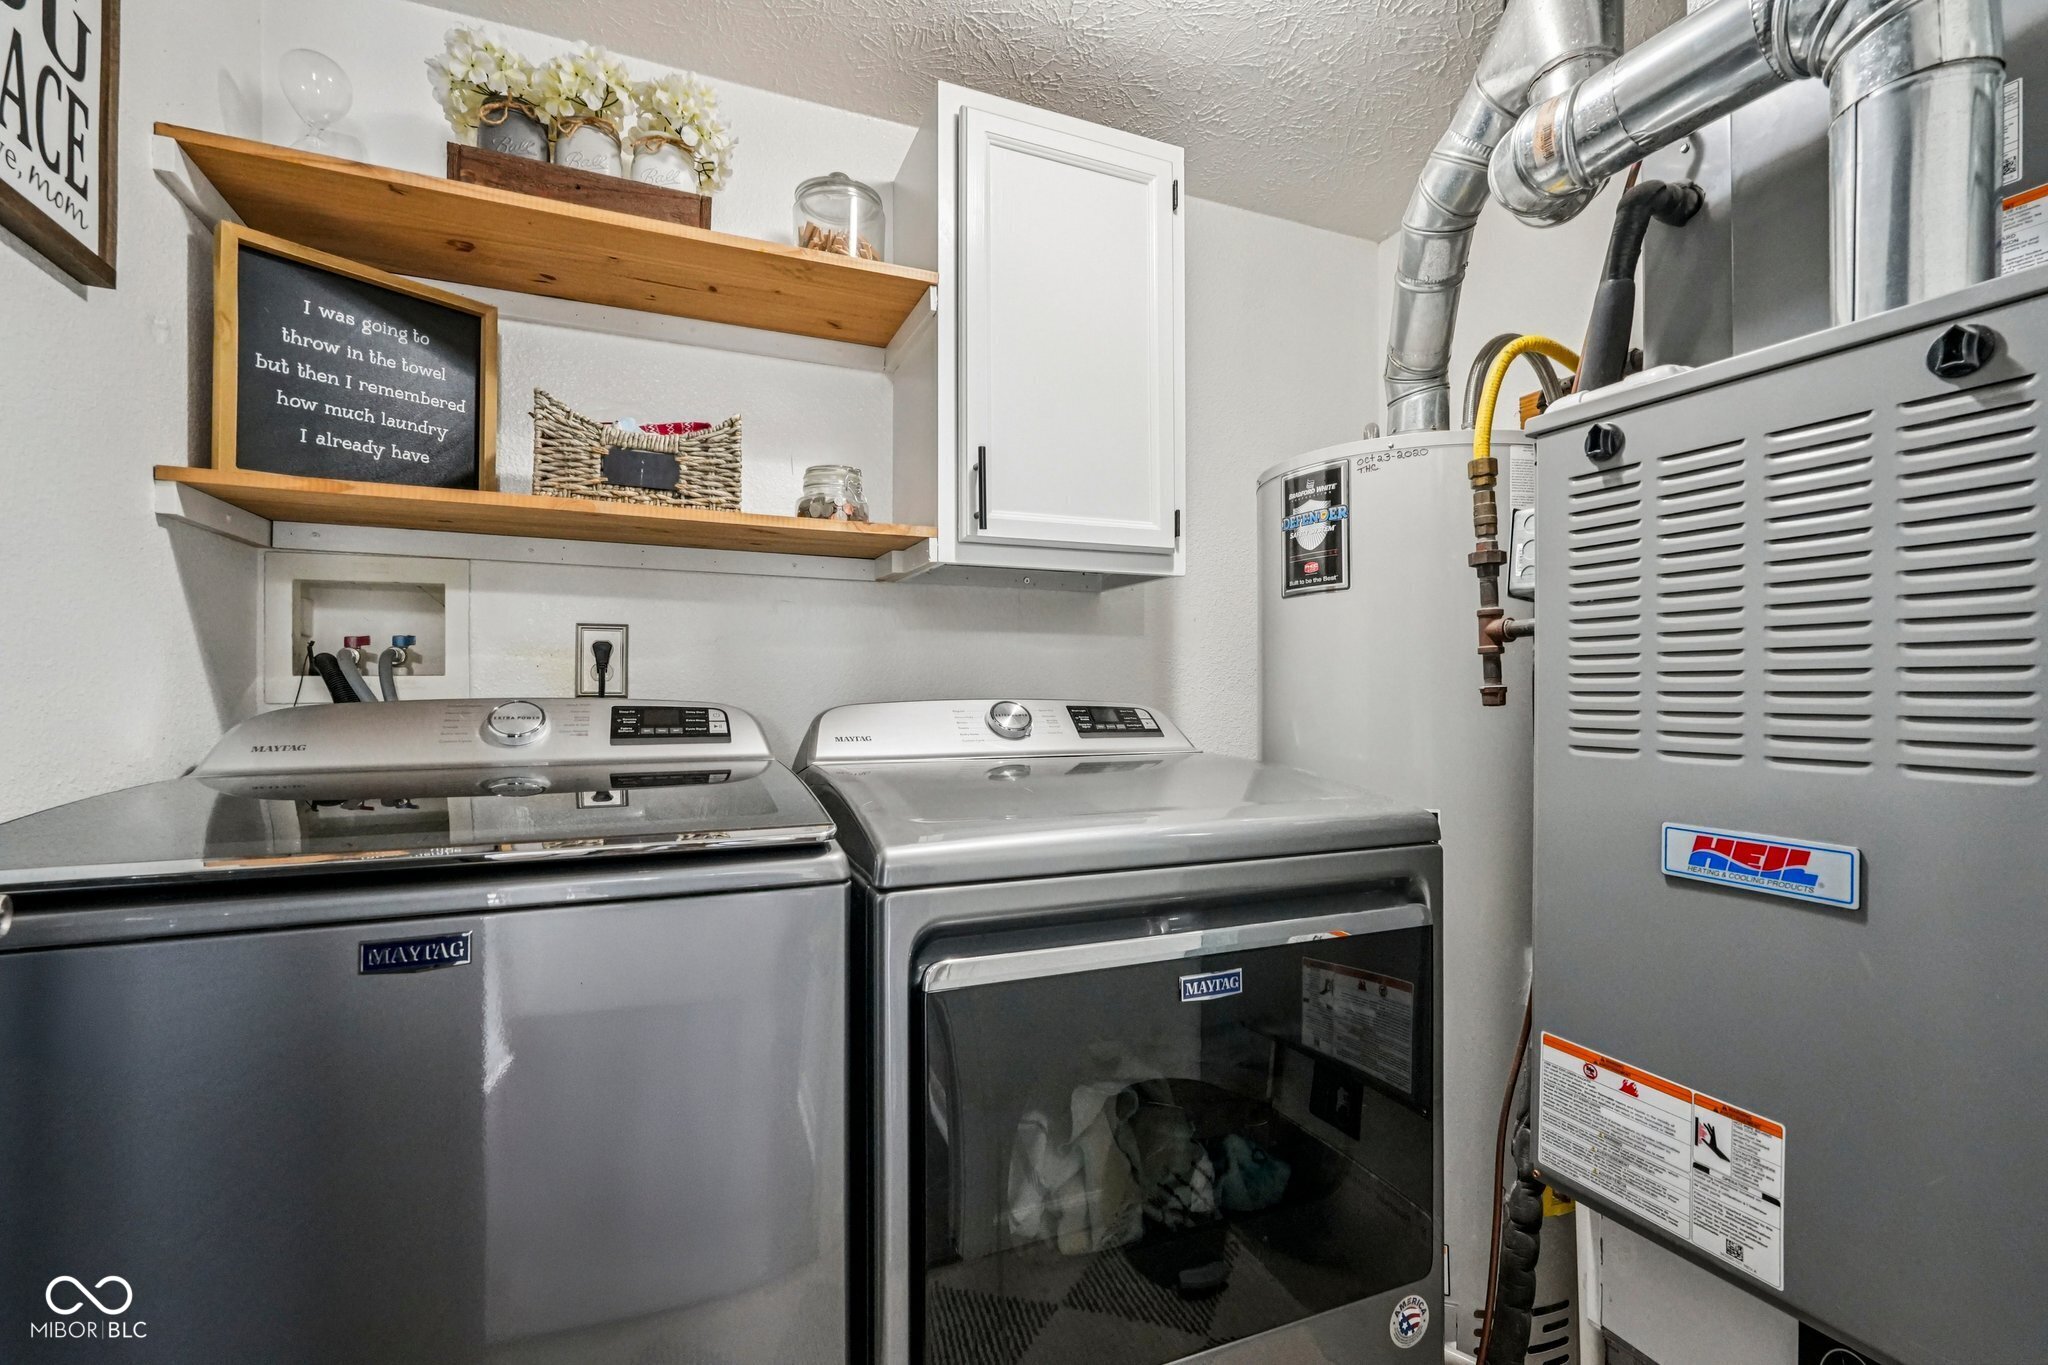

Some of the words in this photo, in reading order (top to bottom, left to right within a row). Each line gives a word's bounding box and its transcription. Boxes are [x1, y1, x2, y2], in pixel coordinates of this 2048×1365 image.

[29, 165, 89, 230] mom
[303, 299, 311, 316] I
[318, 305, 355, 326] was
[361, 319, 408, 345] going
[412, 328, 430, 346] to
[281, 326, 340, 355] throw
[347, 345, 364, 362] in
[369, 349, 396, 369] the
[401, 357, 447, 381] towel
[255, 352, 290, 375] but
[297, 362, 340, 387] then
[345, 374, 353, 389] I
[359, 379, 466, 414] remembered
[276, 389, 318, 411] how
[324, 403, 376, 424] much
[381, 411, 449, 442] laundry
[300, 428, 308, 443] I
[316, 431, 386, 461] already
[391, 443, 431, 464] have
[1280, 505, 1349, 531] DEFENDER
[250, 744, 307, 753] MAYTAG
[834, 735, 872, 743] MAYTAG
[1688, 835, 1819, 887] HEIL
[1687, 865, 1720, 877] HEATING
[1728, 872, 1765, 885] COOLING
[1767, 879, 1815, 894] PRODUCTS
[368, 941, 465, 966] MAYTAG
[1185, 976, 1240, 996] MAYTAG
[1394, 1297, 1427, 1318] AMERICA
